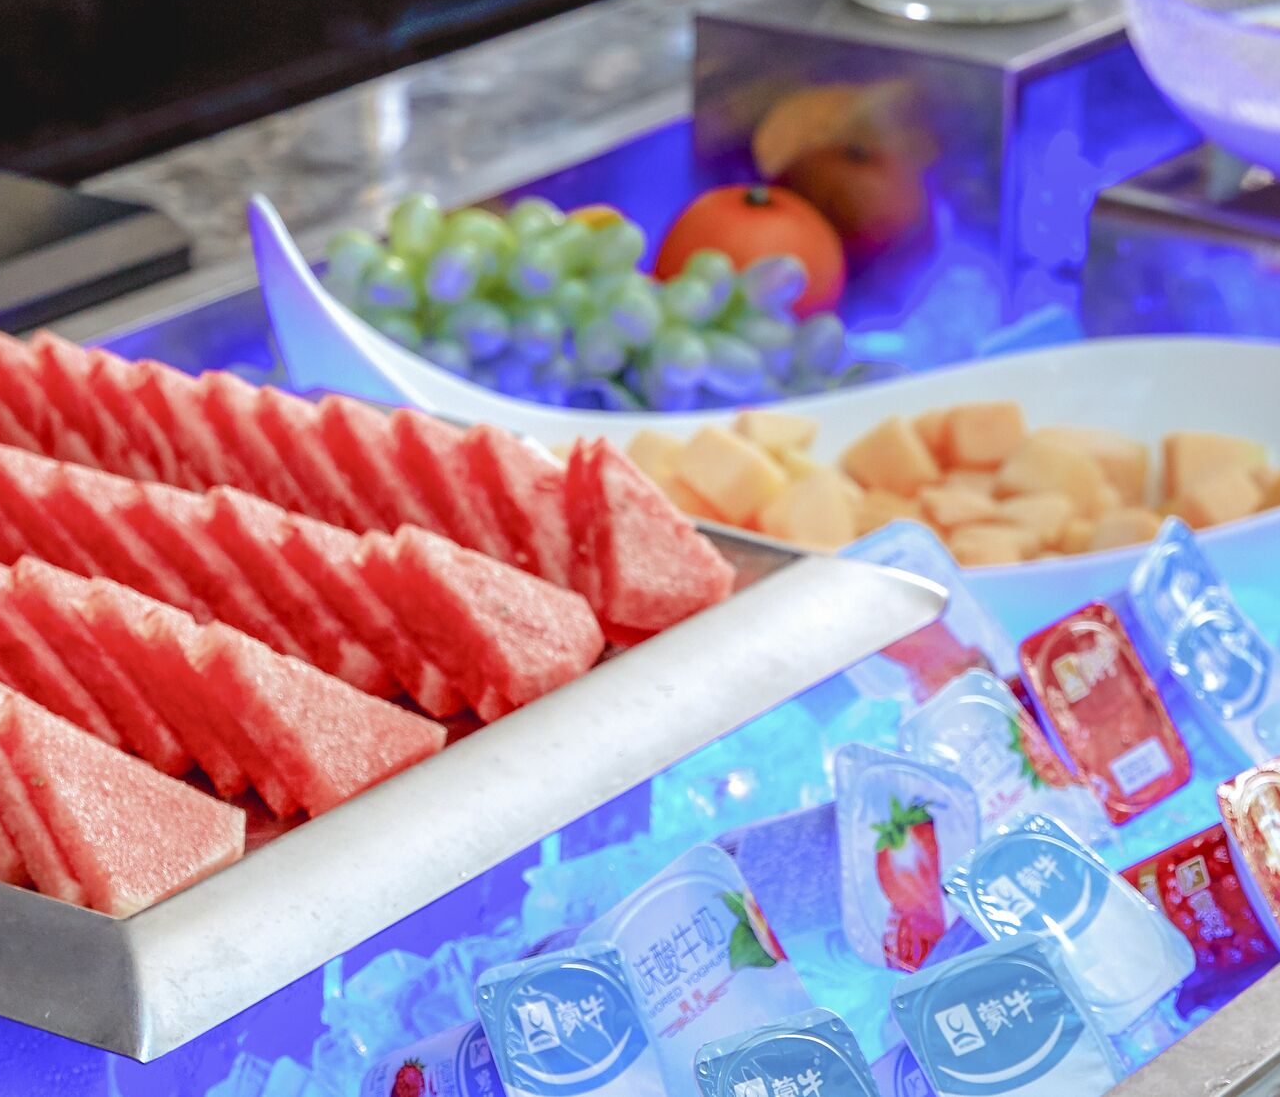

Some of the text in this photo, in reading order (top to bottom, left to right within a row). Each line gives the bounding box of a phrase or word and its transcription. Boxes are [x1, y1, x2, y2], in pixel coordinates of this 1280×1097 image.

[1016, 854, 1066, 897] 蒙牛
[555, 994, 606, 1038] 蒙牛
[976, 989, 1033, 1037] 蒙牛
